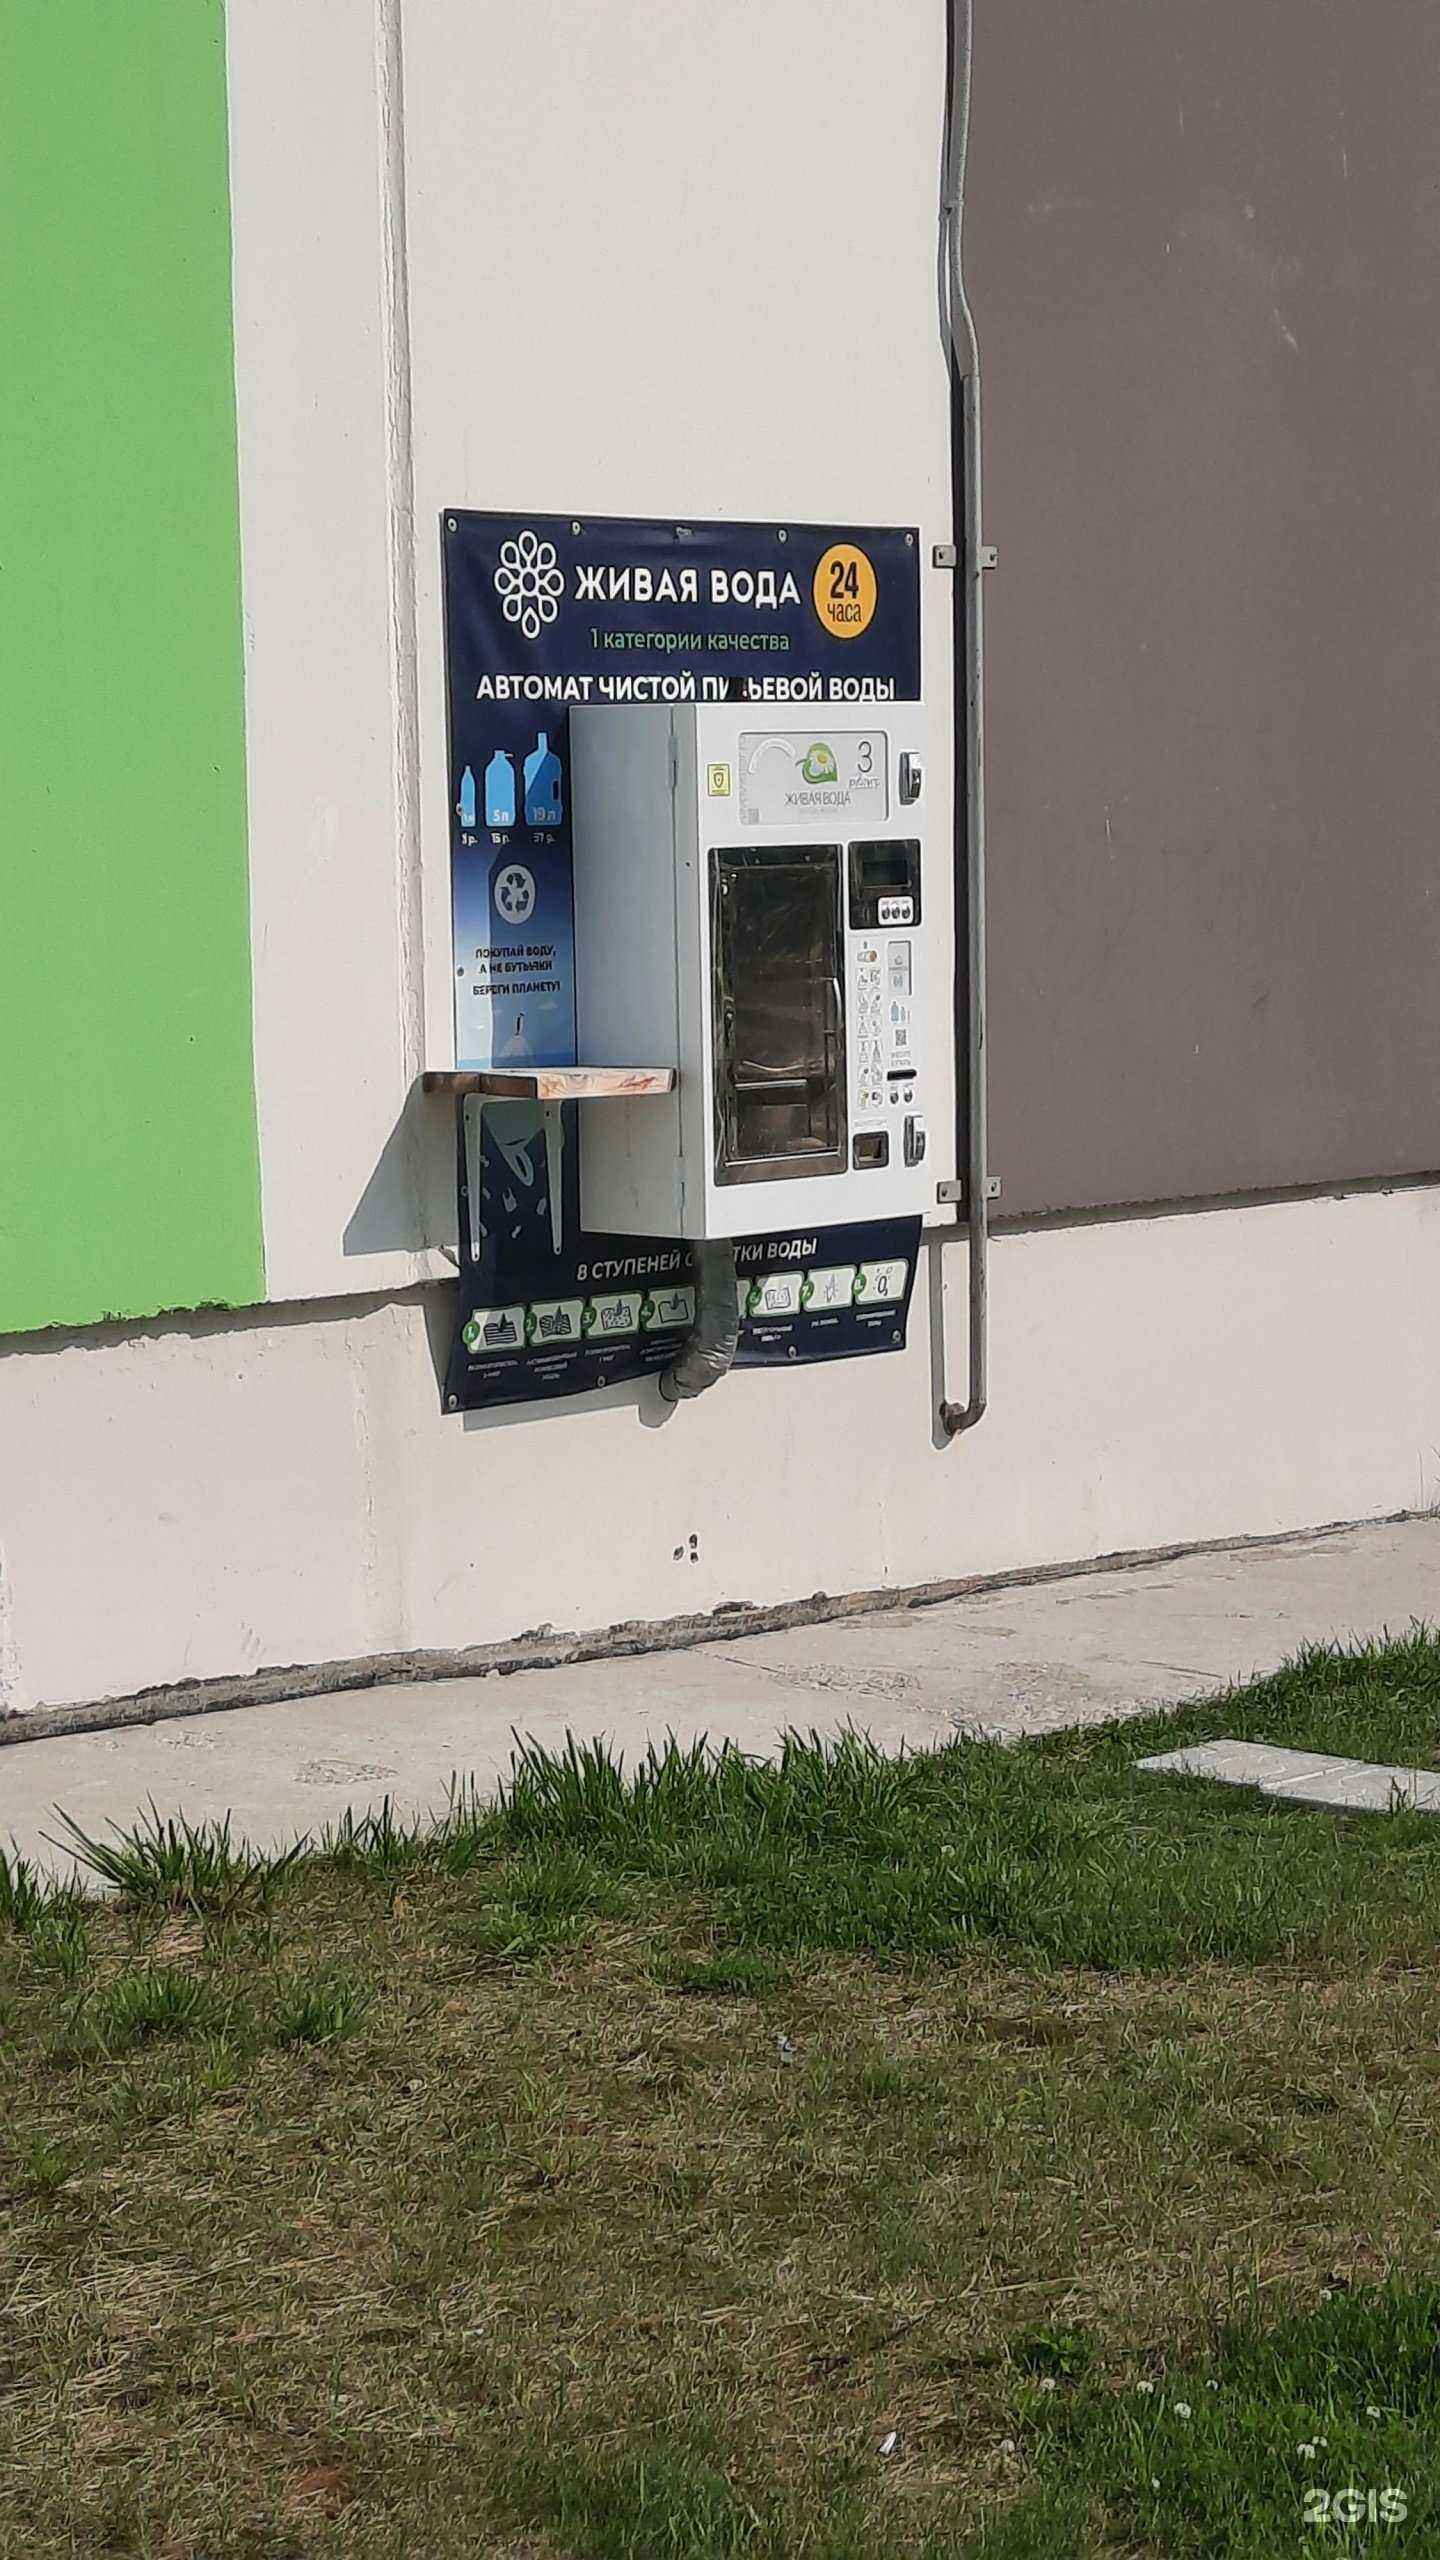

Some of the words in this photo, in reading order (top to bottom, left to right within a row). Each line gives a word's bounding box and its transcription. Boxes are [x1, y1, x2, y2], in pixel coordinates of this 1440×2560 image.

[574, 565, 699, 604] ЖИВАЯ
[710, 569, 801, 610] ВОДА
[829, 561, 860, 599] 24
[826, 601, 863, 624] часа
[590, 627, 599, 648] 1
[602, 629, 703, 653] категории
[706, 632, 790, 652] качества
[476, 674, 593, 701] АВТОМАТ
[597, 671, 696, 700] ЧИСТОЙ
[702, 671, 823, 701] ПИЬЕВОЙ
[828, 677, 895, 702] ВОДЫ
[856, 741, 873, 773] 3
[475, 944, 523, 958] ПОКУПАЙ
[526, 944, 556, 957] ВОДУ,
[489, 962, 502, 973] НЕ
[472, 983, 510, 996] БЕРЕГИ
[577, 1263, 588, 1281] 8
[591, 1248, 682, 1280] СТУПЕНЕЙ
[767, 1236, 818, 1264] ВОДЫ
